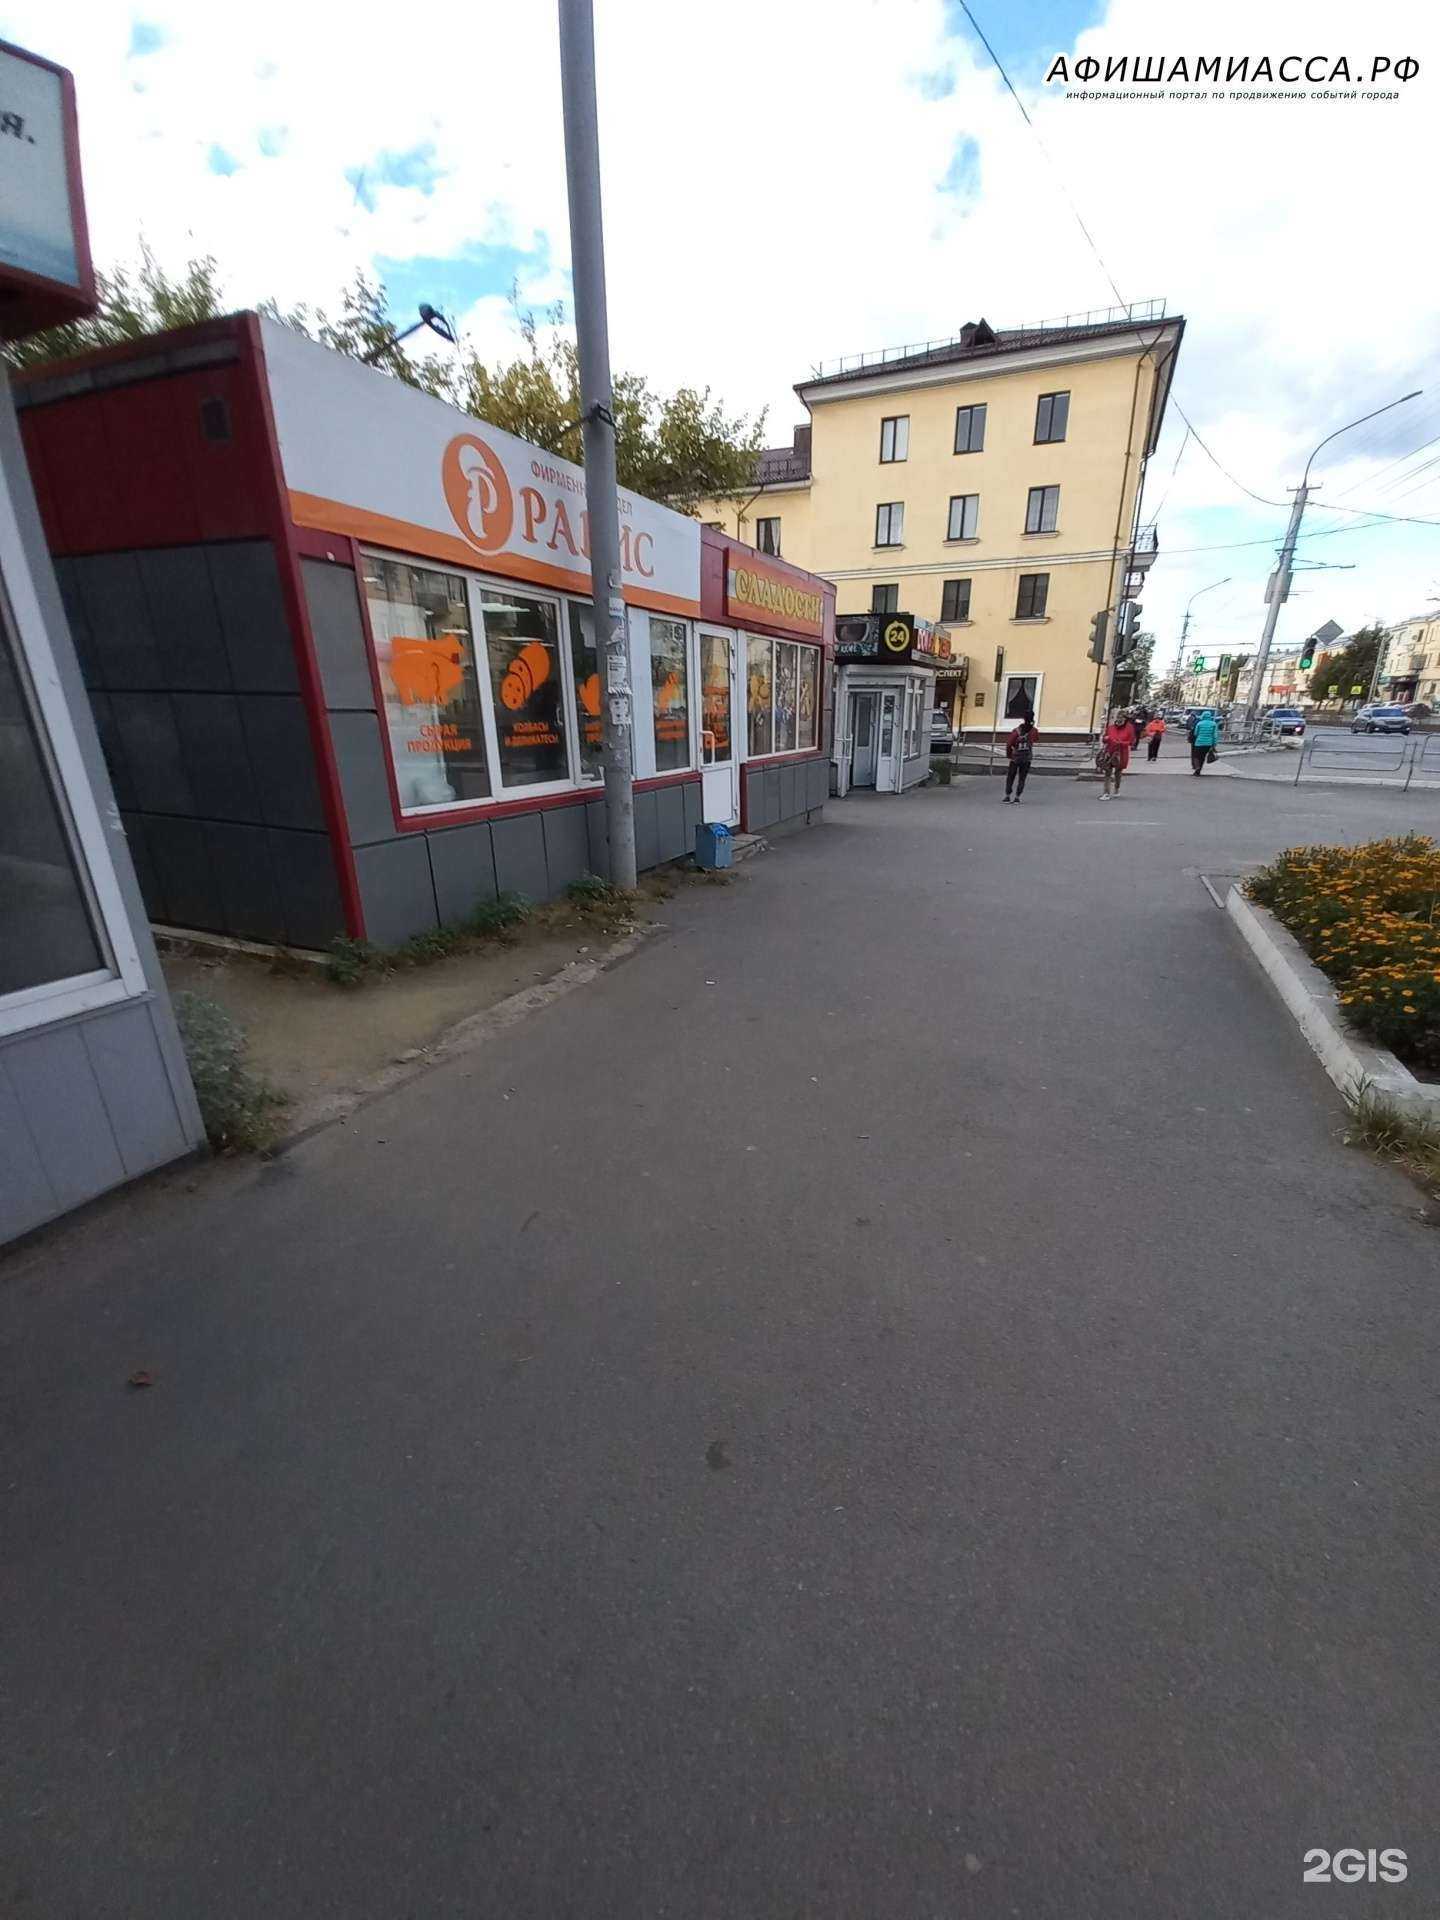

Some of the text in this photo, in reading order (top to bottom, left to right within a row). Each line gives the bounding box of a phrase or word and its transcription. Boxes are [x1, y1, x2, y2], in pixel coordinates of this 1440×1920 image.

[530, 460, 632, 516] ФИРМЕНН ДЕЛ
[890, 629, 905, 643] 24
